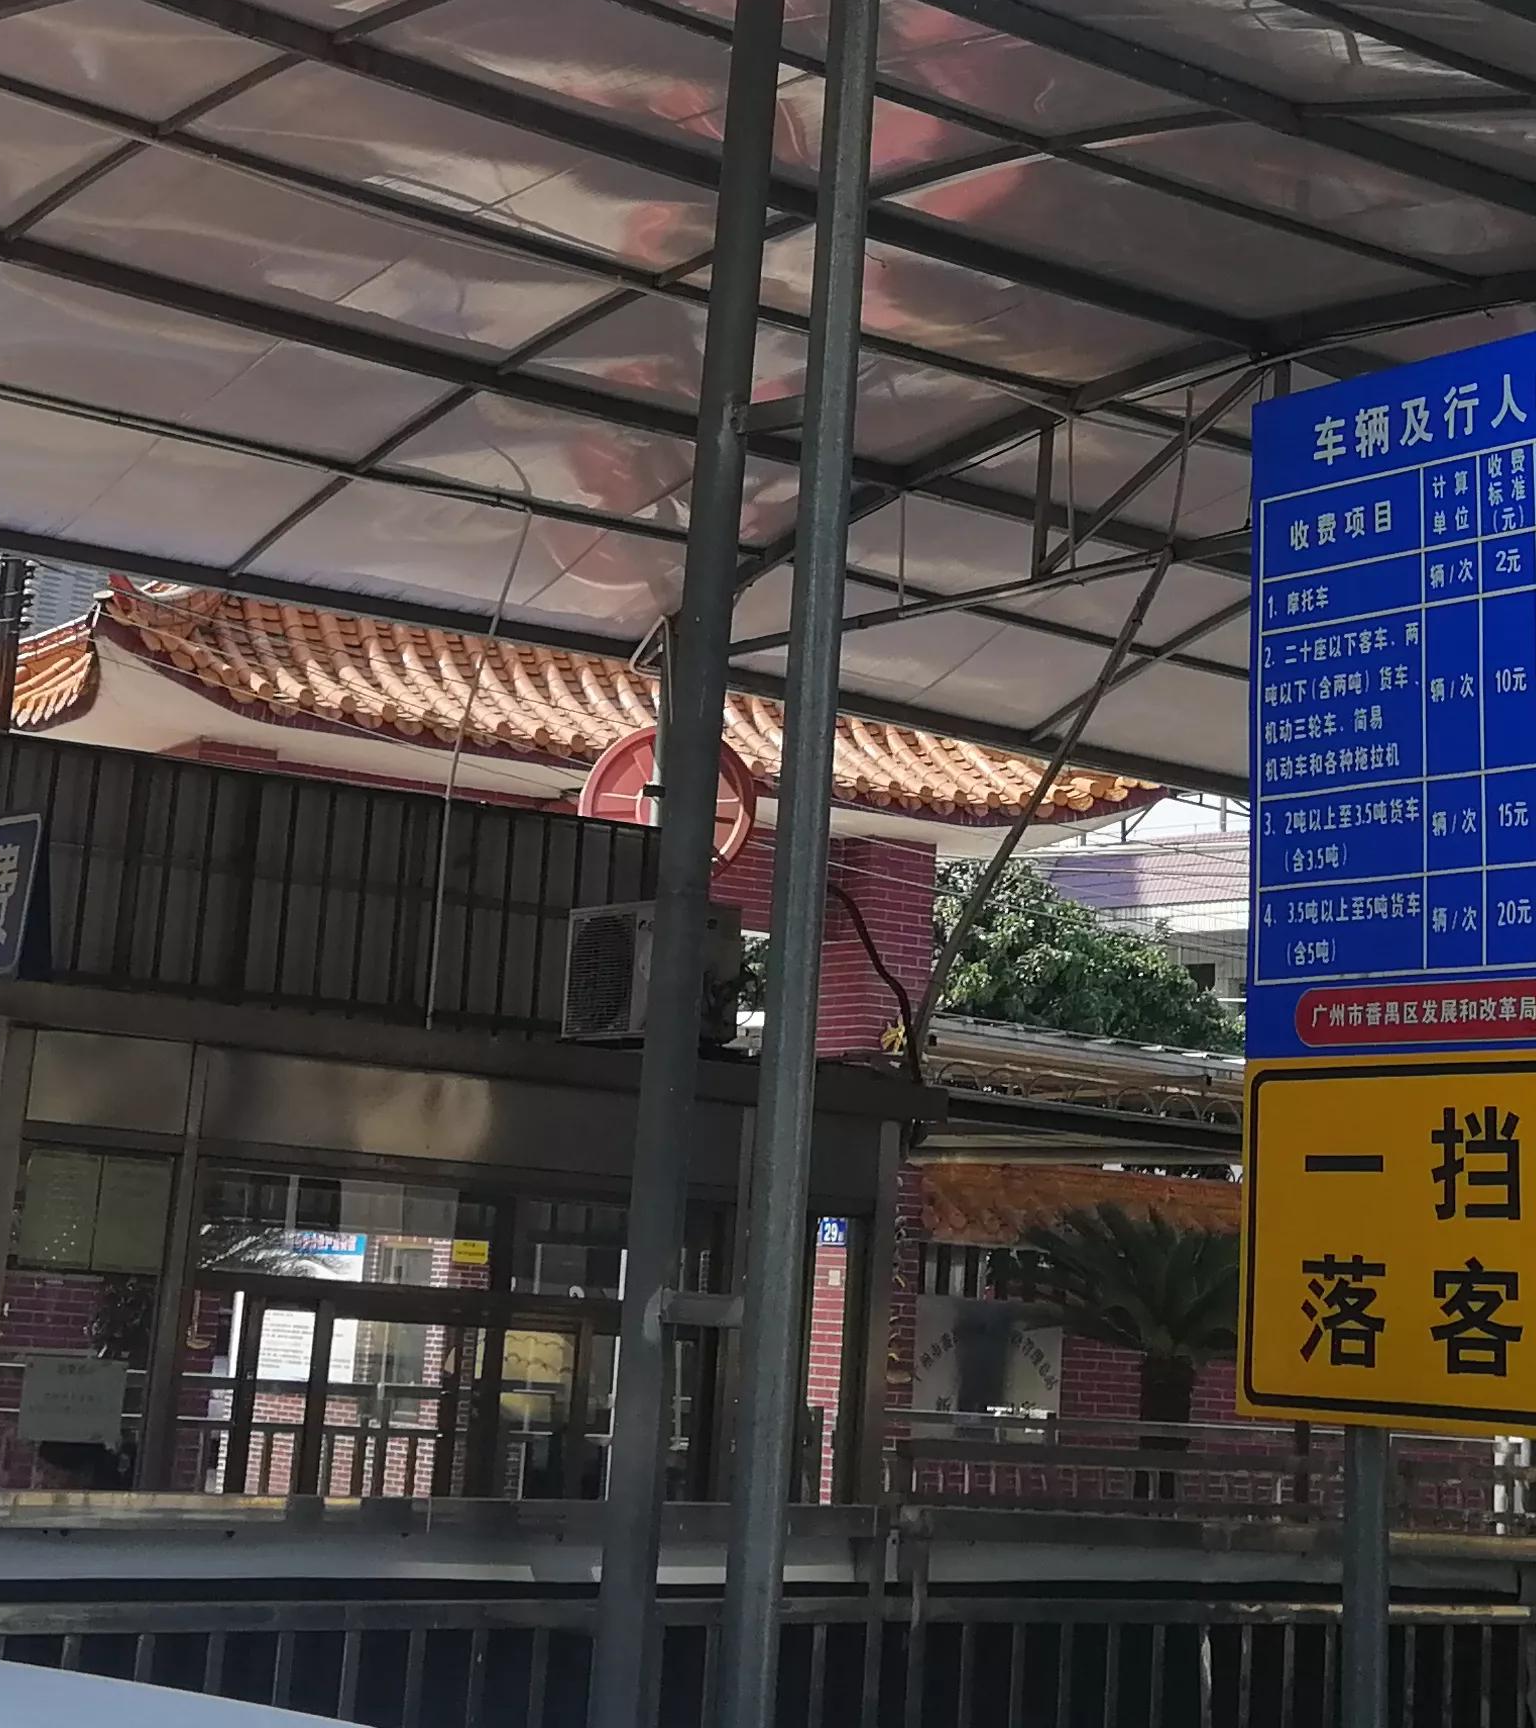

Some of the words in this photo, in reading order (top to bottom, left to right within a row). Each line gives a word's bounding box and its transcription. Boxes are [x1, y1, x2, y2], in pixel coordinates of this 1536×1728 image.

[1488, 448, 1525, 478] 收费
[1433, 471, 1468, 499] 计算
[1488, 477, 1526, 506] 标准
[1290, 500, 1391, 551] 收费项目
[1433, 506, 1469, 535] 单位
[1430, 558, 1473, 589] 辆/次
[1496, 548, 1521, 573] 2元
[1430, 672, 1474, 703] 辆/次
[1496, 667, 1527, 693] 10元
[1265, 743, 1399, 782] 机动车和各种拖拉机
[1432, 808, 1476, 837] 辆/次
[1499, 801, 1528, 827] 15元
[1432, 904, 1477, 933] 辆/次
[1497, 899, 1532, 926] 20元
[1312, 996, 1536, 1028] 广州市番禺区发展和改革局
